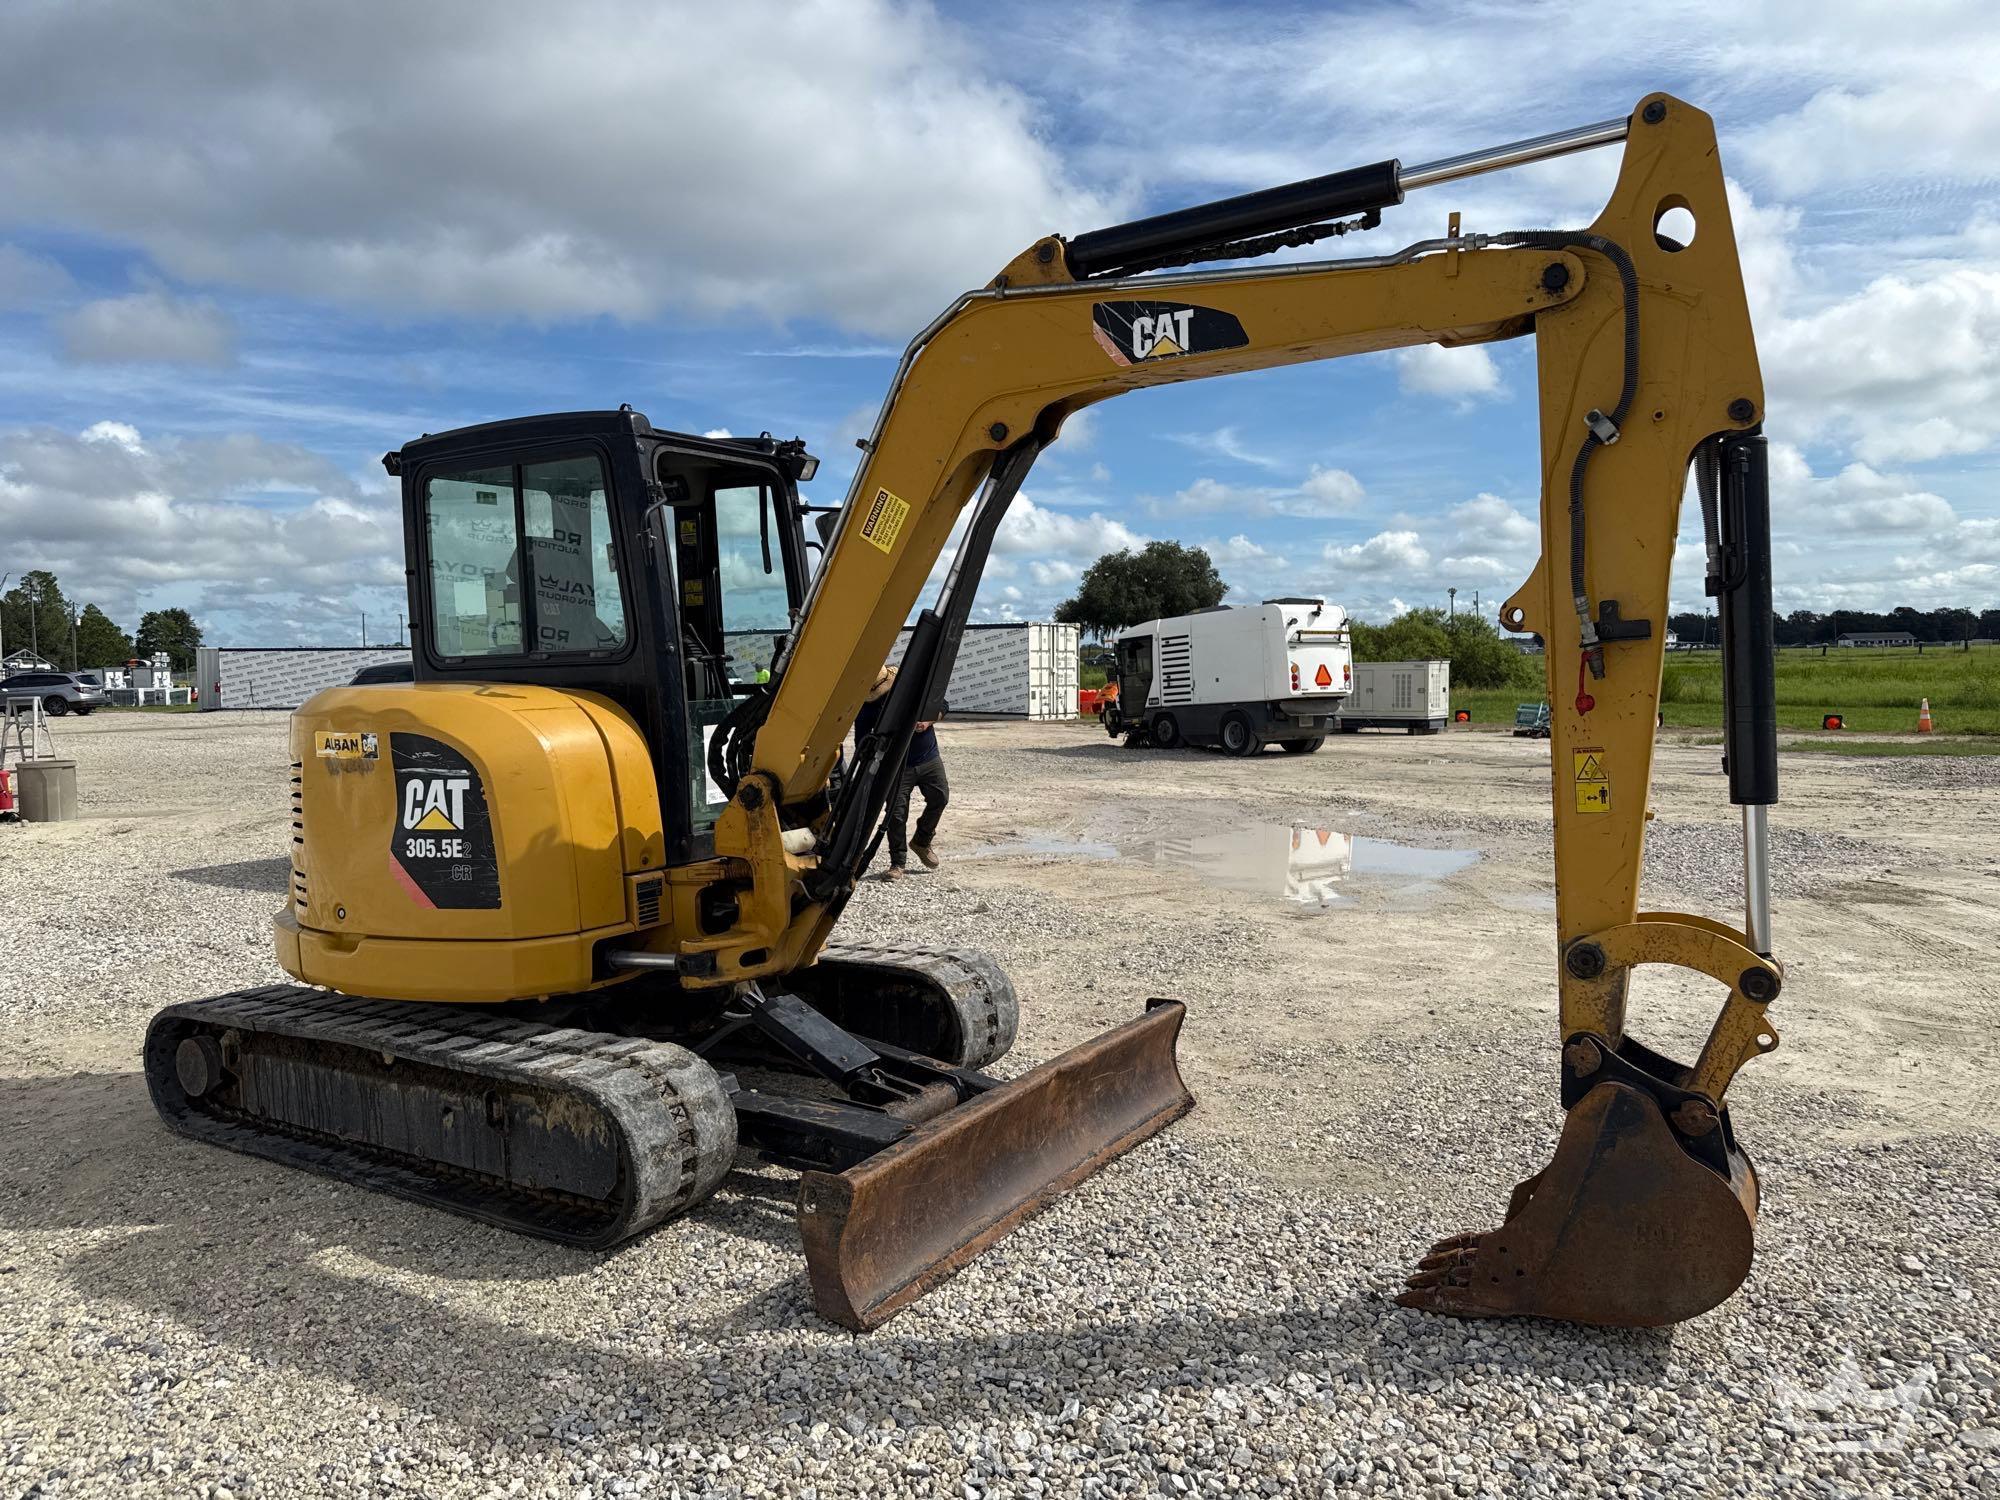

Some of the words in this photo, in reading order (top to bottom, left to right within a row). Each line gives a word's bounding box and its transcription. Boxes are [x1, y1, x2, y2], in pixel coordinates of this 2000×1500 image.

[1132, 308, 1194, 359] CAT
[864, 493, 887, 535] WARNING
[324, 738, 359, 751] ALBAN
[403, 778, 470, 830] CAT
[406, 838, 472, 858] 305.5E2
[451, 864, 473, 881] CR
